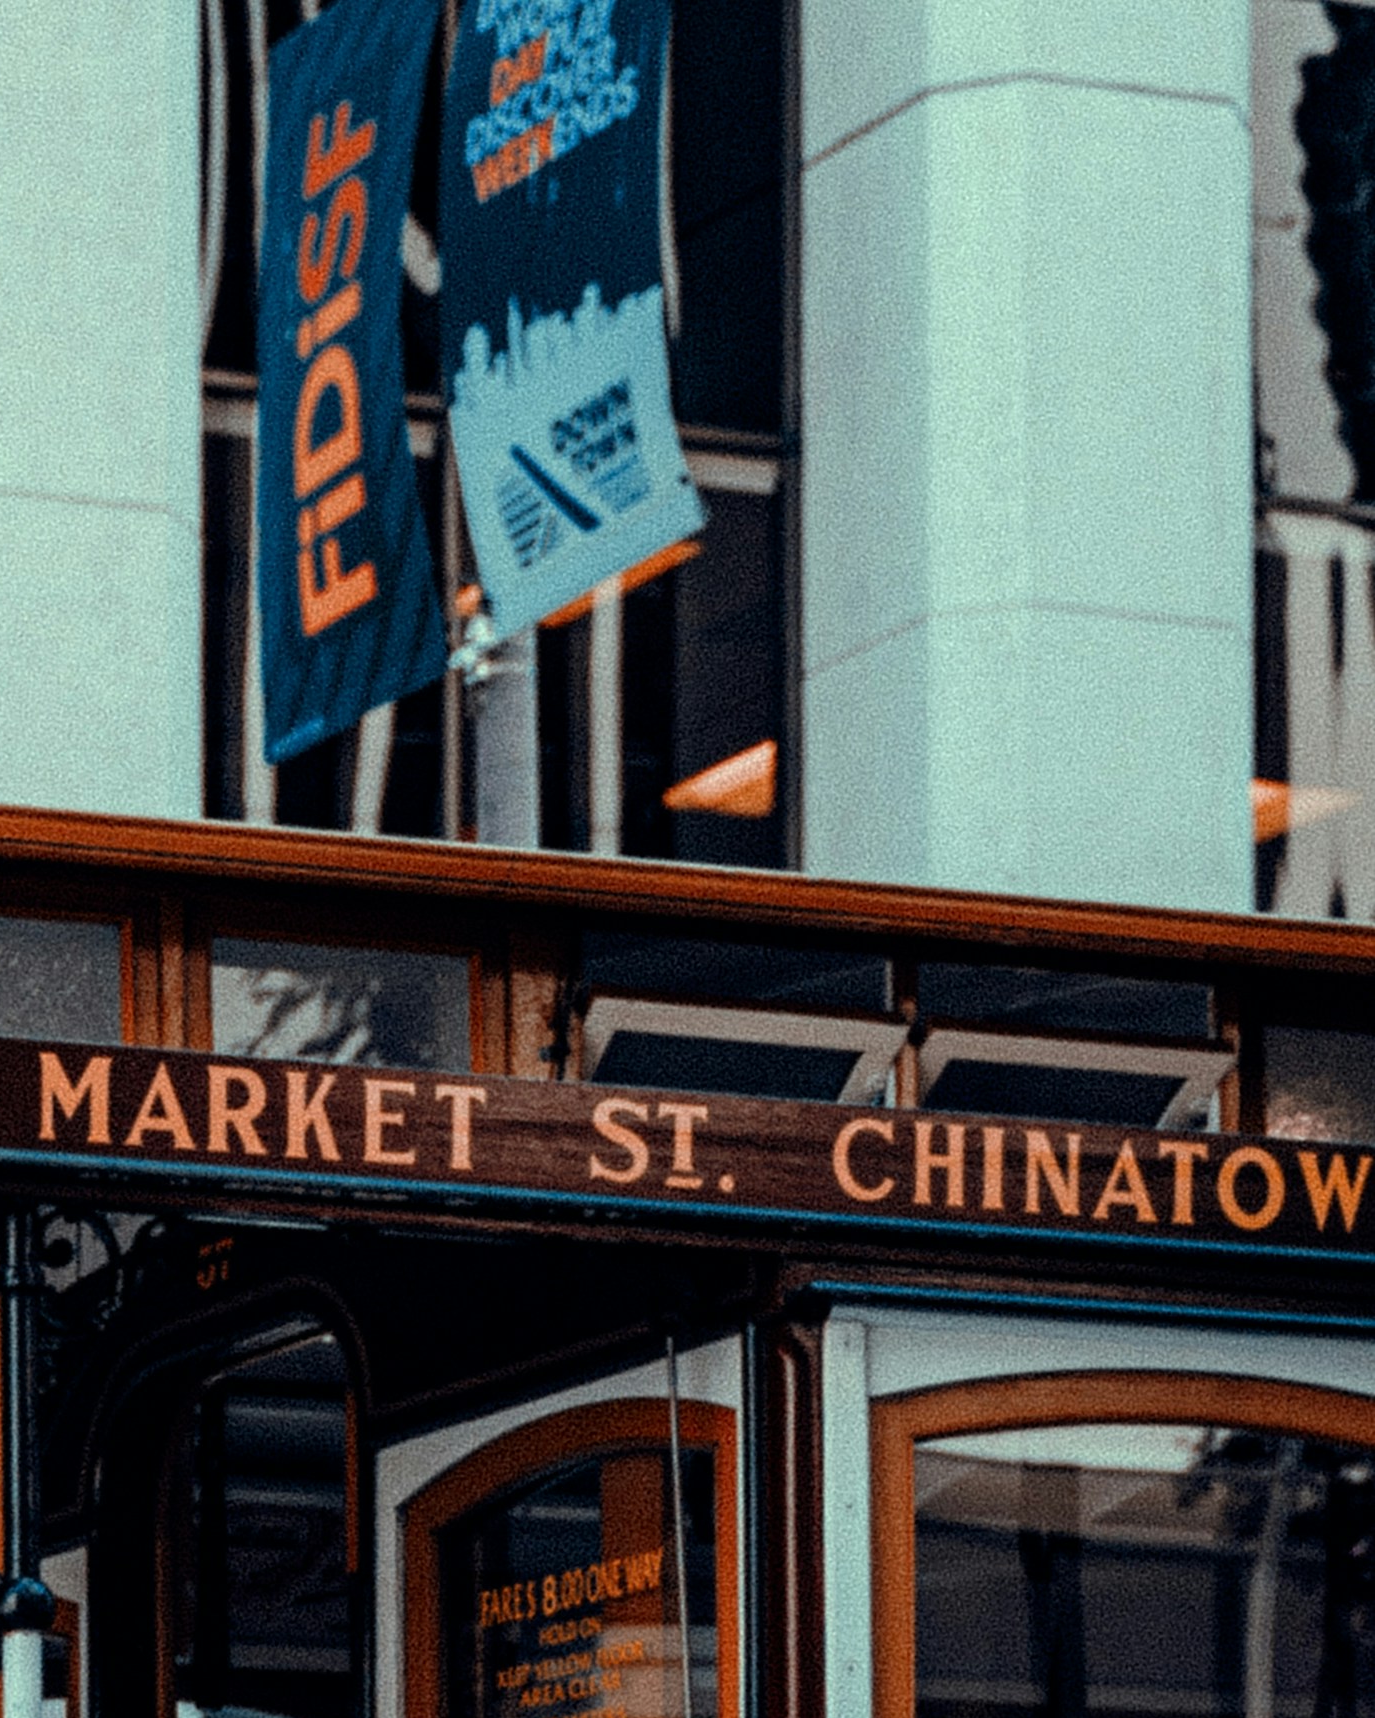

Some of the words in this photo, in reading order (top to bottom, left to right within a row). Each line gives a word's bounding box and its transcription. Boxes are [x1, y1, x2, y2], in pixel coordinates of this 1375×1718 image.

[38, 1051, 487, 1173] MARKET
[589, 1097, 735, 1194] ST.
[195, 1236, 236, 1291] 57
